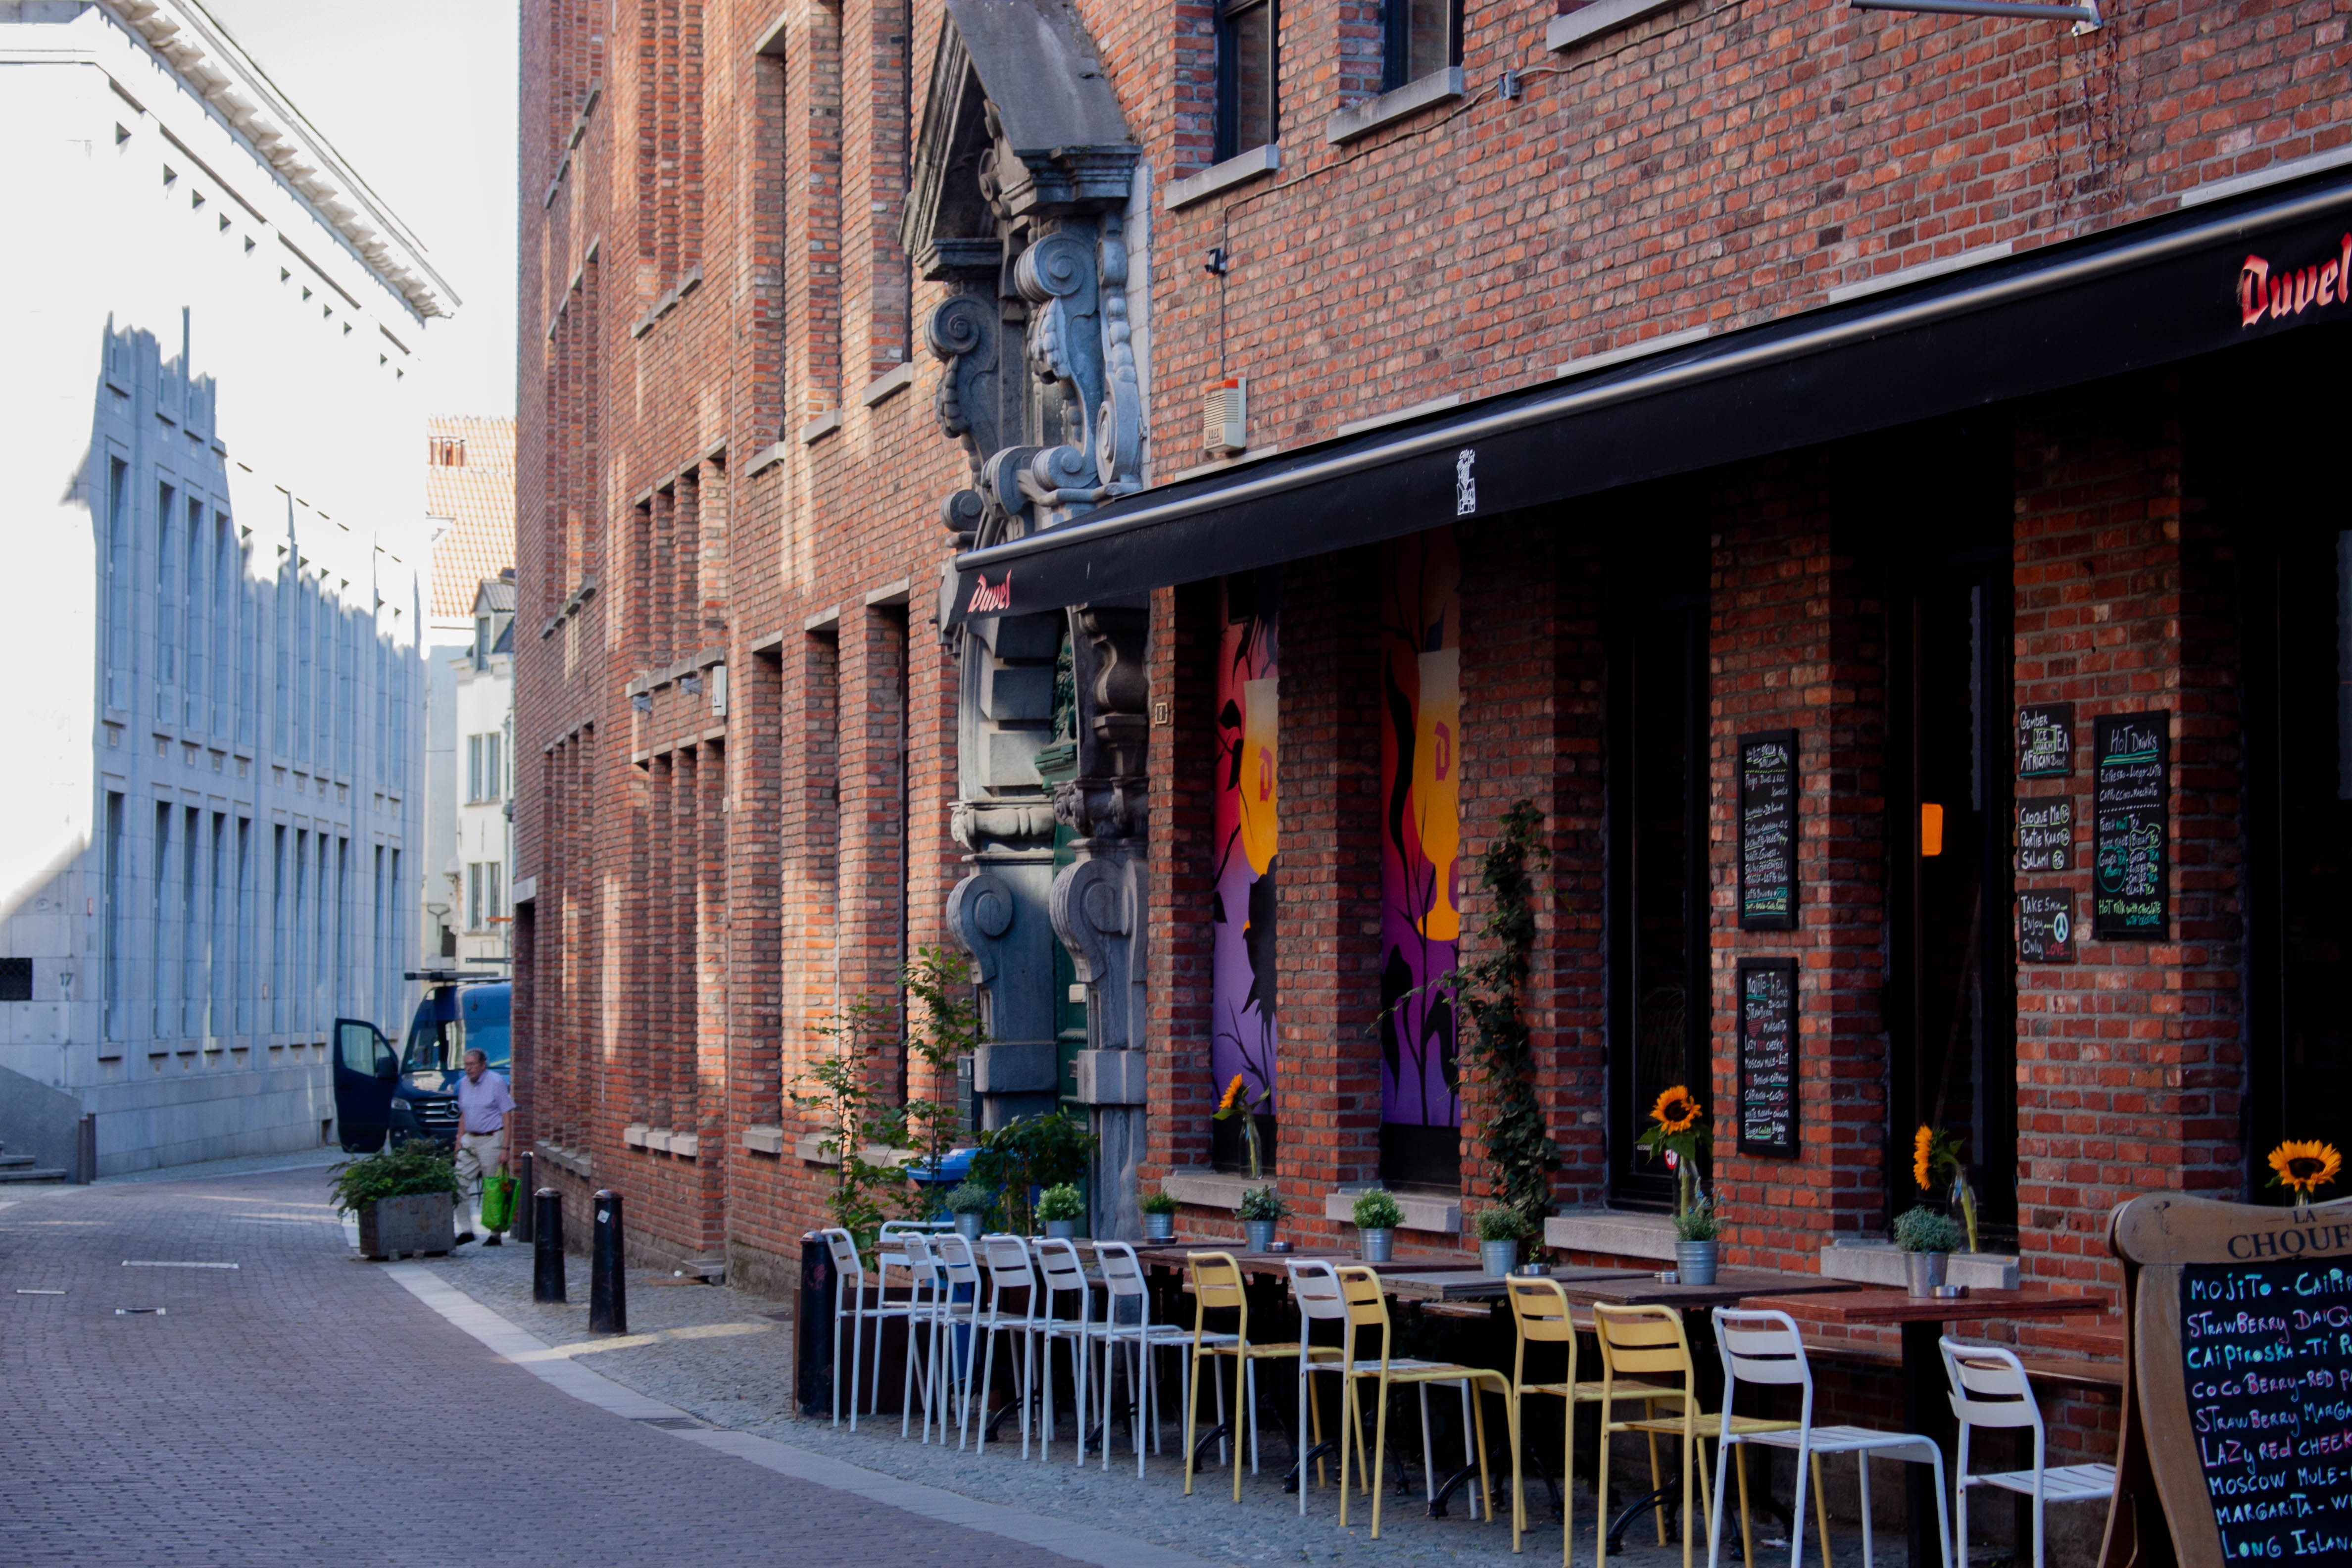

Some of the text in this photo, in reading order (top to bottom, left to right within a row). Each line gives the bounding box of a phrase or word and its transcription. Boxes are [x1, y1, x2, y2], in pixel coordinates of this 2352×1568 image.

[2242, 232, 2352, 328] Duvel
[967, 568, 1012, 613] Duvel
[2035, 743, 2053, 752] WARM
[2036, 730, 2047, 741] ICE
[2051, 724, 2069, 752] TEA
[2020, 807, 2048, 825] CROQUE
[2021, 895, 2043, 914] TAKE
[60, 973, 74, 986] 17
[2293, 1209, 2317, 1224] LA
[2227, 1224, 2352, 1260] CHOUF
[2208, 1470, 2286, 1496] MOSCOW
[2221, 1530, 2282, 1558] LONG
